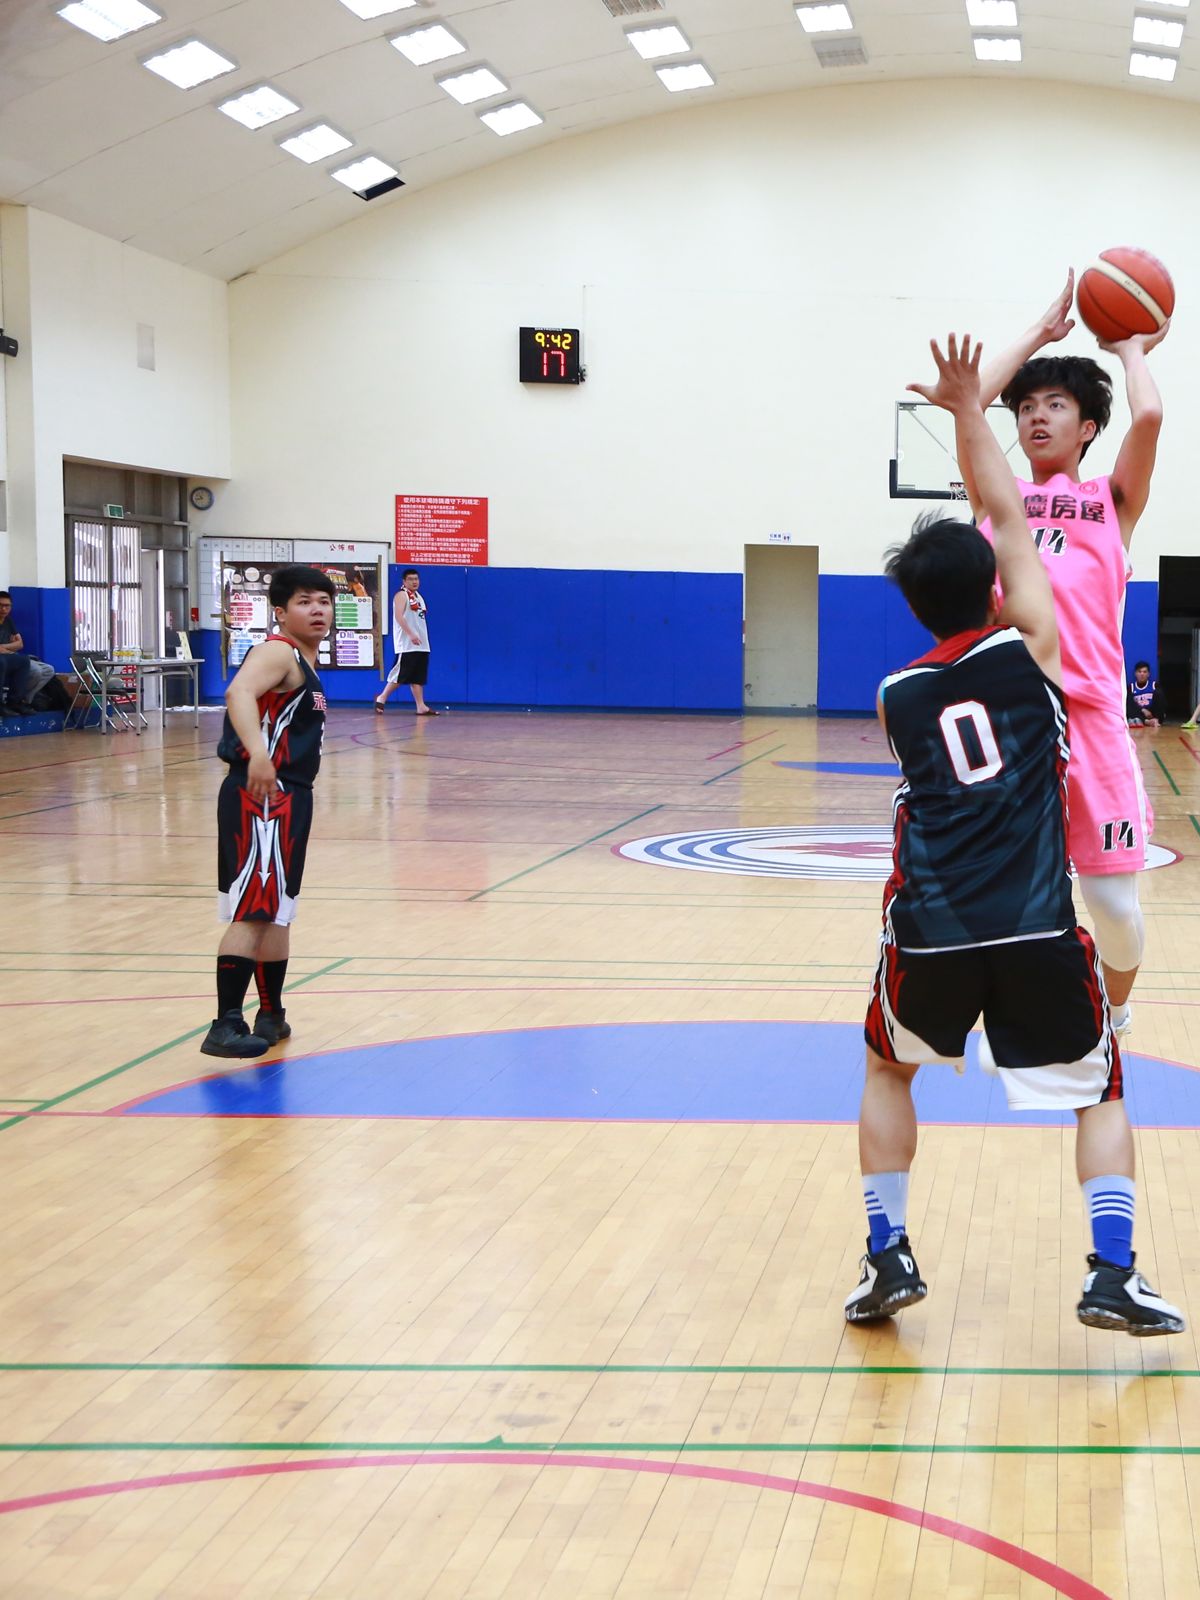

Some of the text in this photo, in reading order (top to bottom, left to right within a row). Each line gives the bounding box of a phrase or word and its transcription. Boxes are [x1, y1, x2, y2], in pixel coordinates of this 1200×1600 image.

[535, 332, 572, 350] 9:42
[543, 350, 565, 377] 17
[1023, 494, 1106, 524] 慶房屋
[1031, 527, 1067, 556] 14
[938, 699, 1005, 785] 0
[1099, 819, 1137, 852] 14
